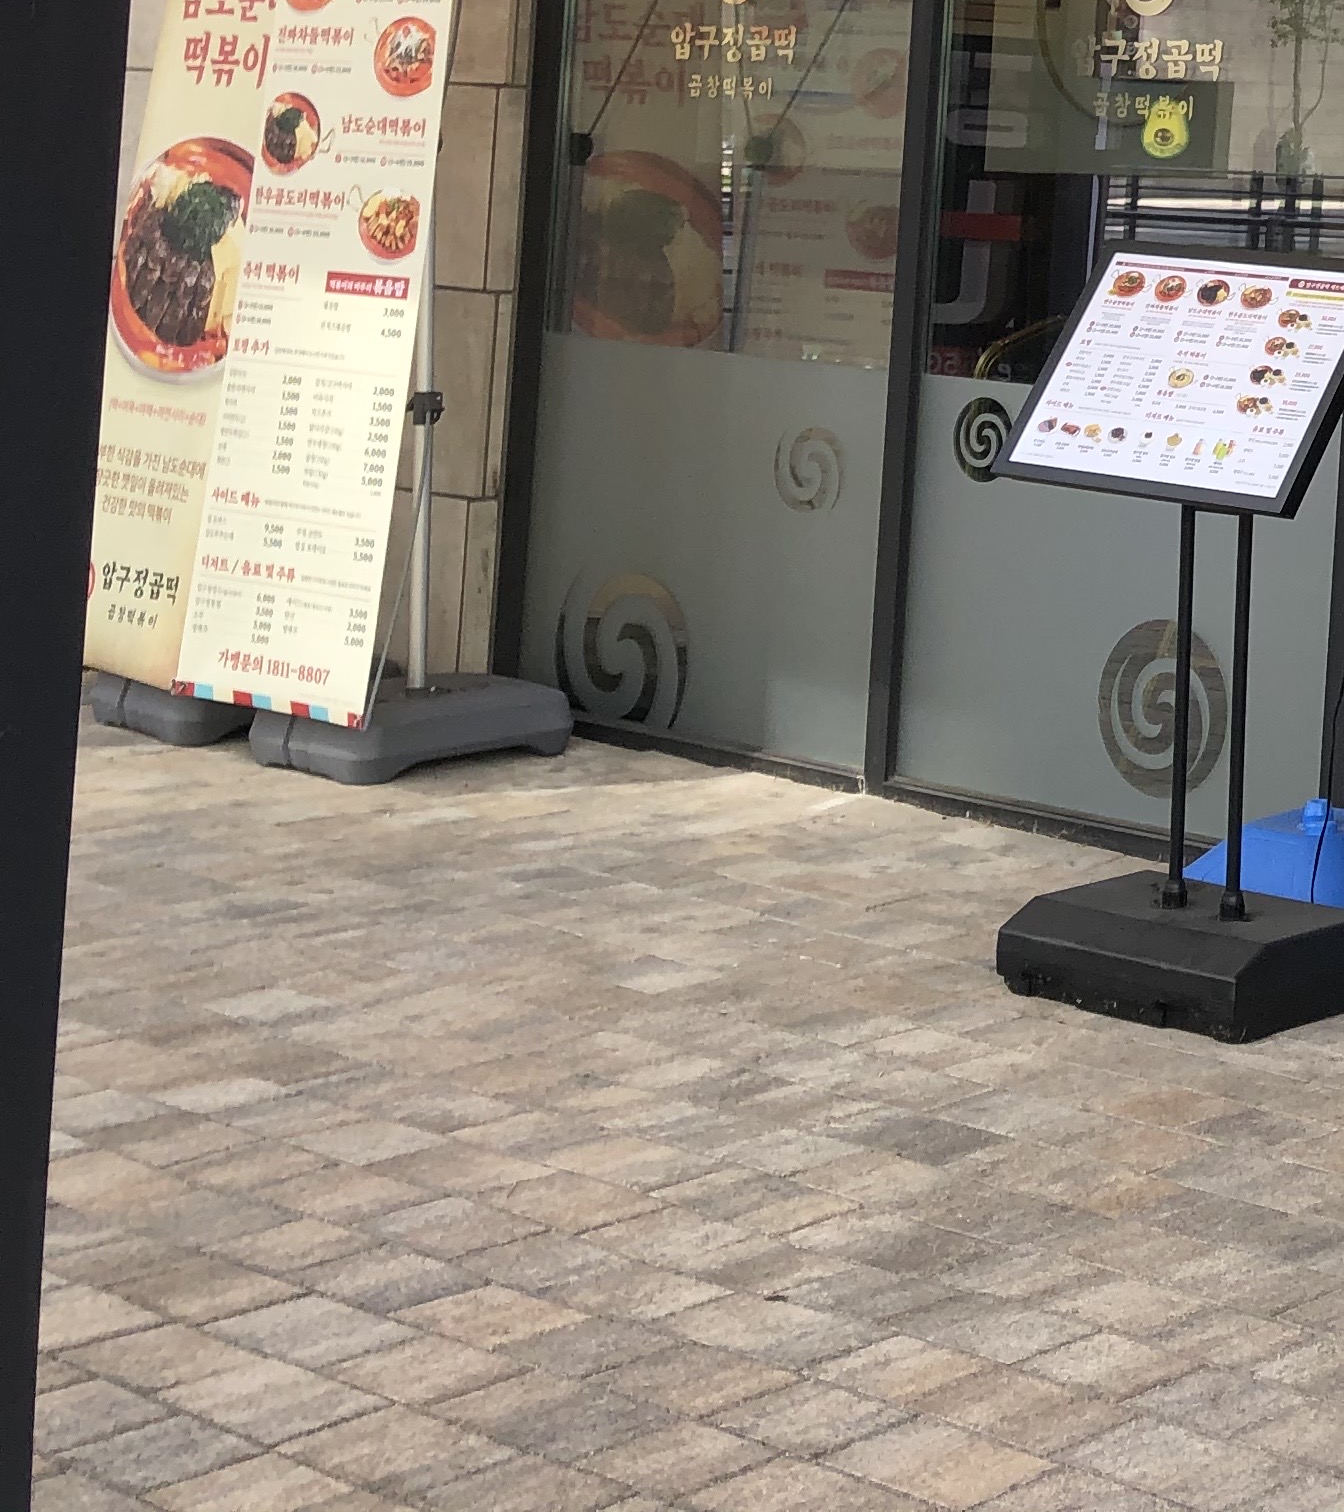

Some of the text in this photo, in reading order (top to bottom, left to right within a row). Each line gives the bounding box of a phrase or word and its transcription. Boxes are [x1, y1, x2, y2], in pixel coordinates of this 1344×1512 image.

[184, 32, 271, 90] 떡볶이
[670, 22, 798, 65] 압구정곱떡
[688, 75, 774, 100] 곱창떡볶이
[101, 561, 180, 606] 압구정곱떡
[218, 648, 330, 686] 가맹문의 1811-8807
